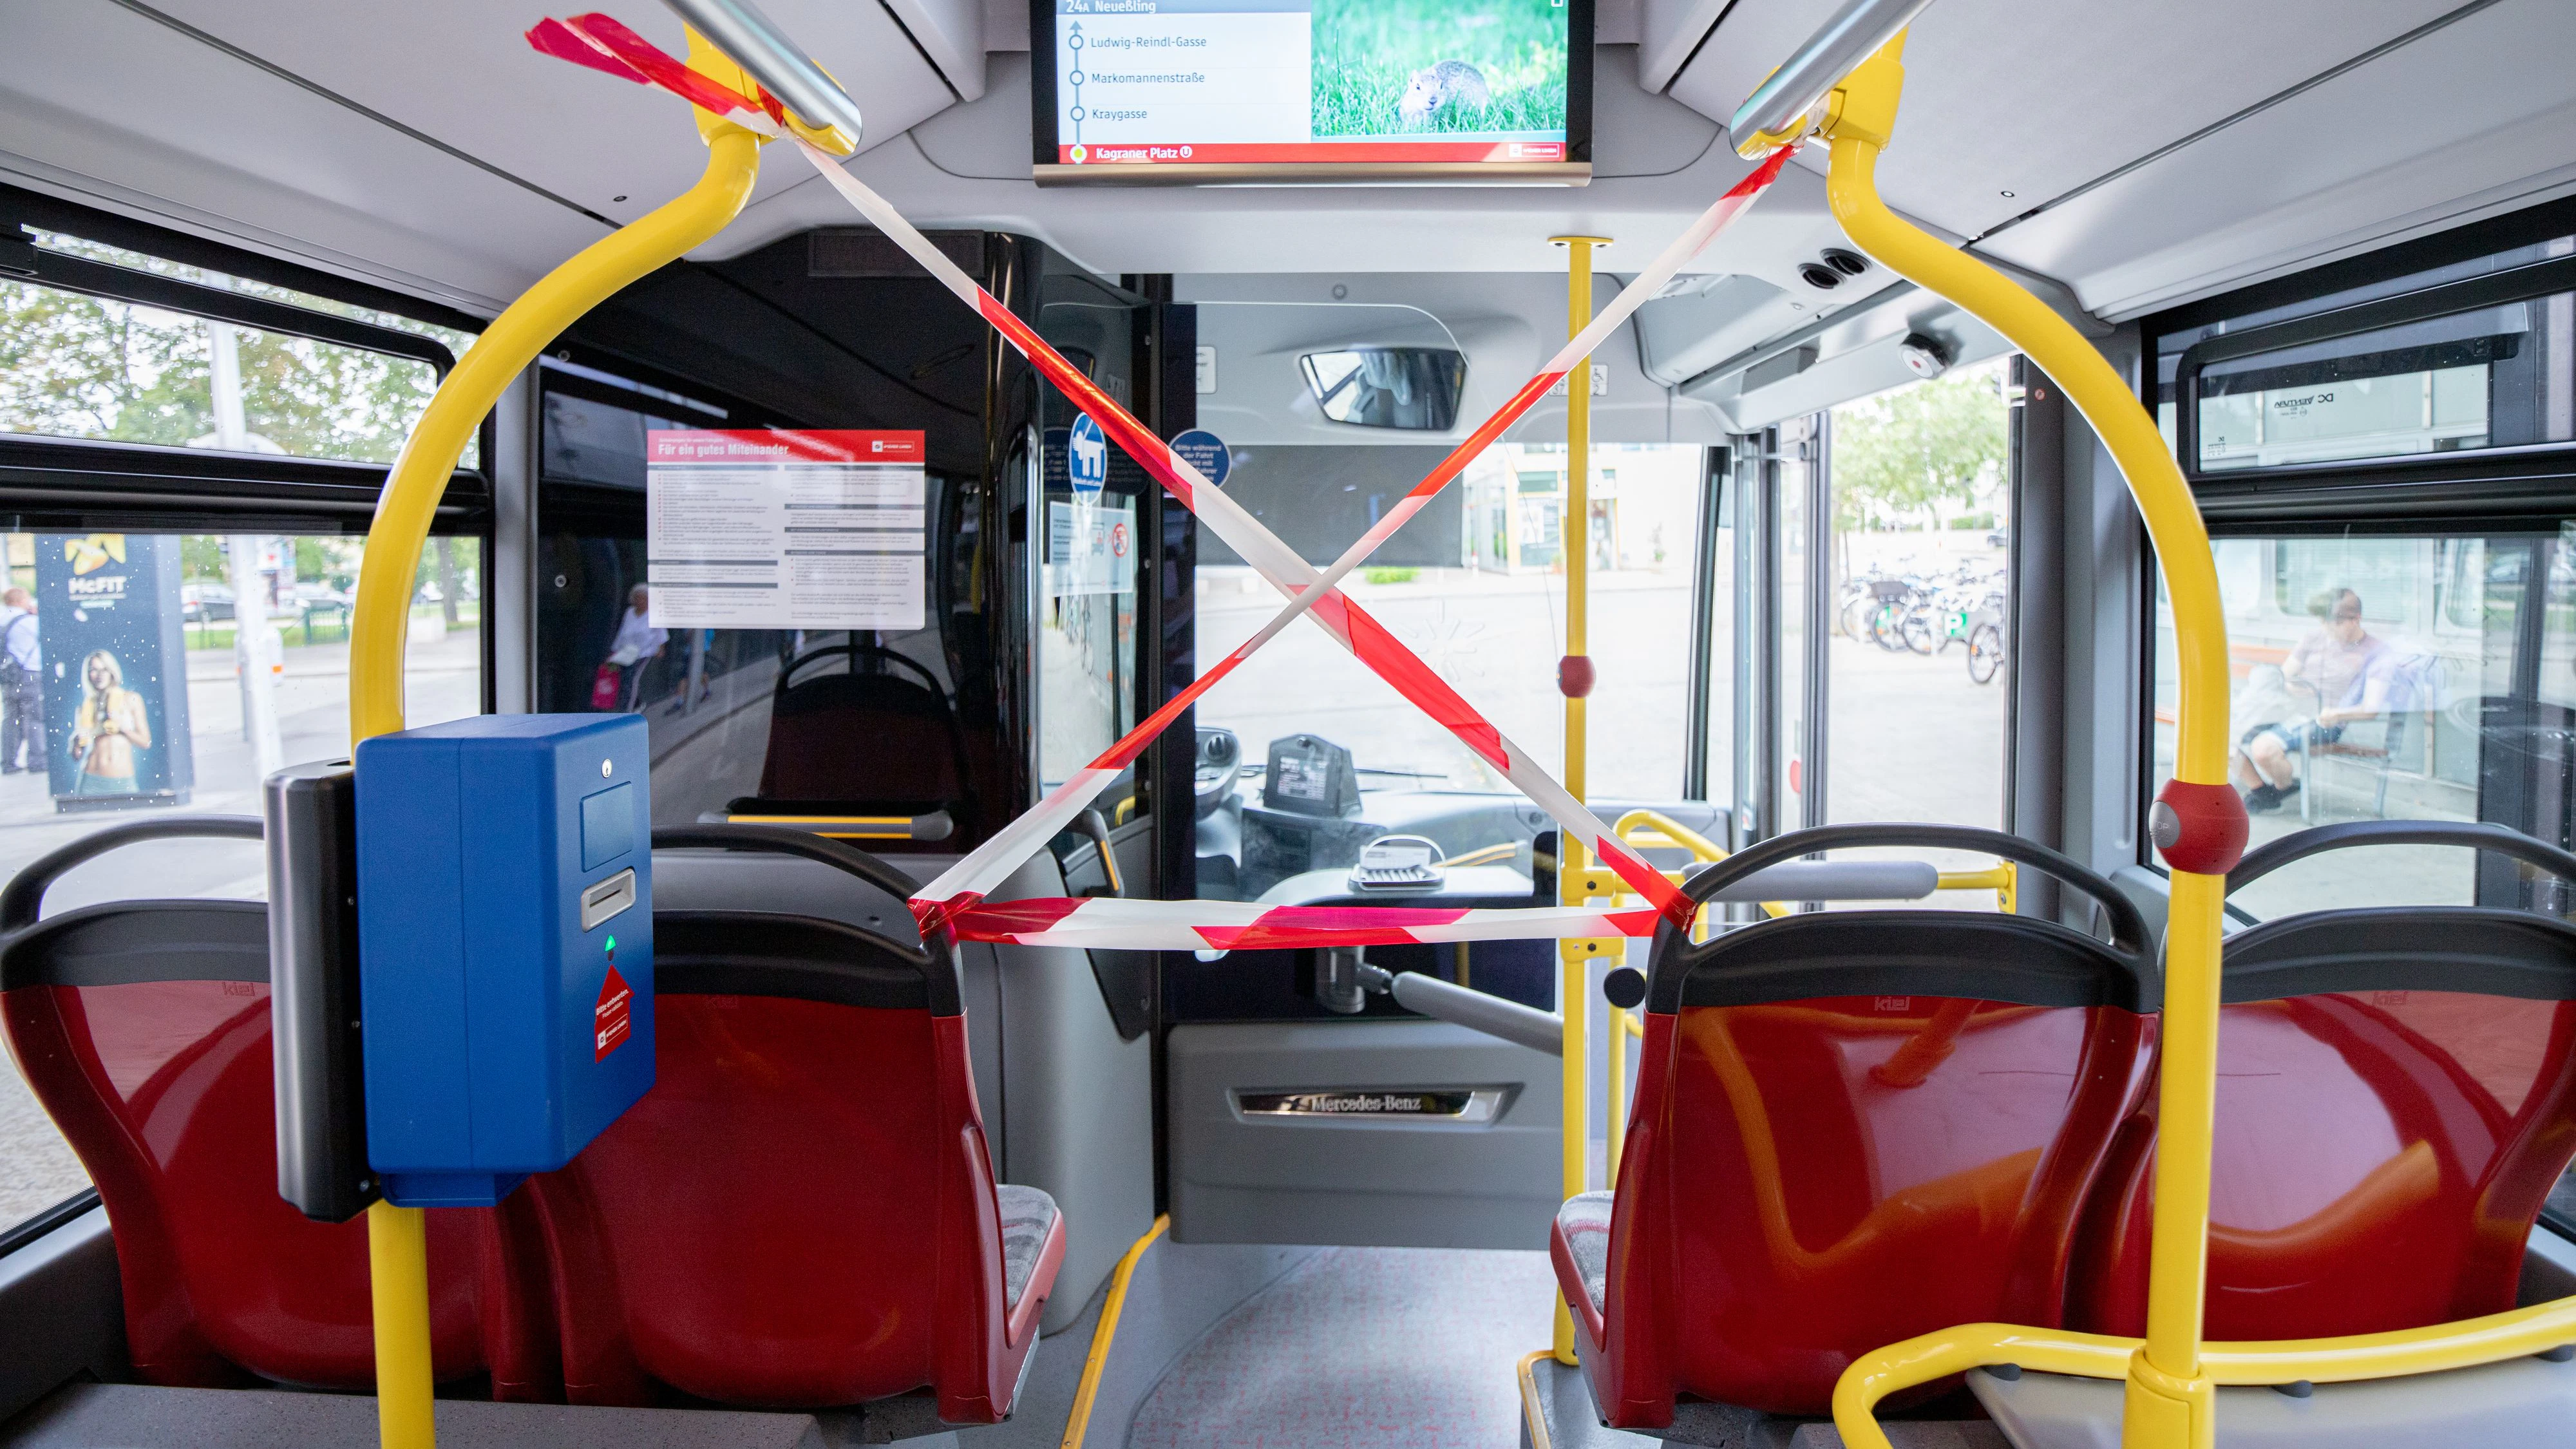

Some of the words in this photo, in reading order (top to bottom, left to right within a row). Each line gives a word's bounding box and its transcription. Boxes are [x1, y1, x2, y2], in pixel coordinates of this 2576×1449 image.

[1066, 0, 1090, 13] 24A
[1095, 0, 1156, 14] Neueßling
[1091, 37, 1207, 49] Ludwig-Reindl-Gasse
[1092, 72, 1205, 83] Markomannenstraße
[1092, 109, 1148, 121] Kraygasse
[1096, 147, 1148, 160] Kagraner
[1150, 147, 1178, 158] Platz
[658, 444, 676, 455] Für
[678, 444, 694, 455] ein
[697, 444, 724, 457] gutes
[728, 444, 789, 455] Miteinander
[68, 576, 127, 594] McFIT
[1945, 613, 1964, 637] P
[596, 1004, 607, 1016] Bitte
[1311, 1095, 1421, 1112] Mercedes-Benz
